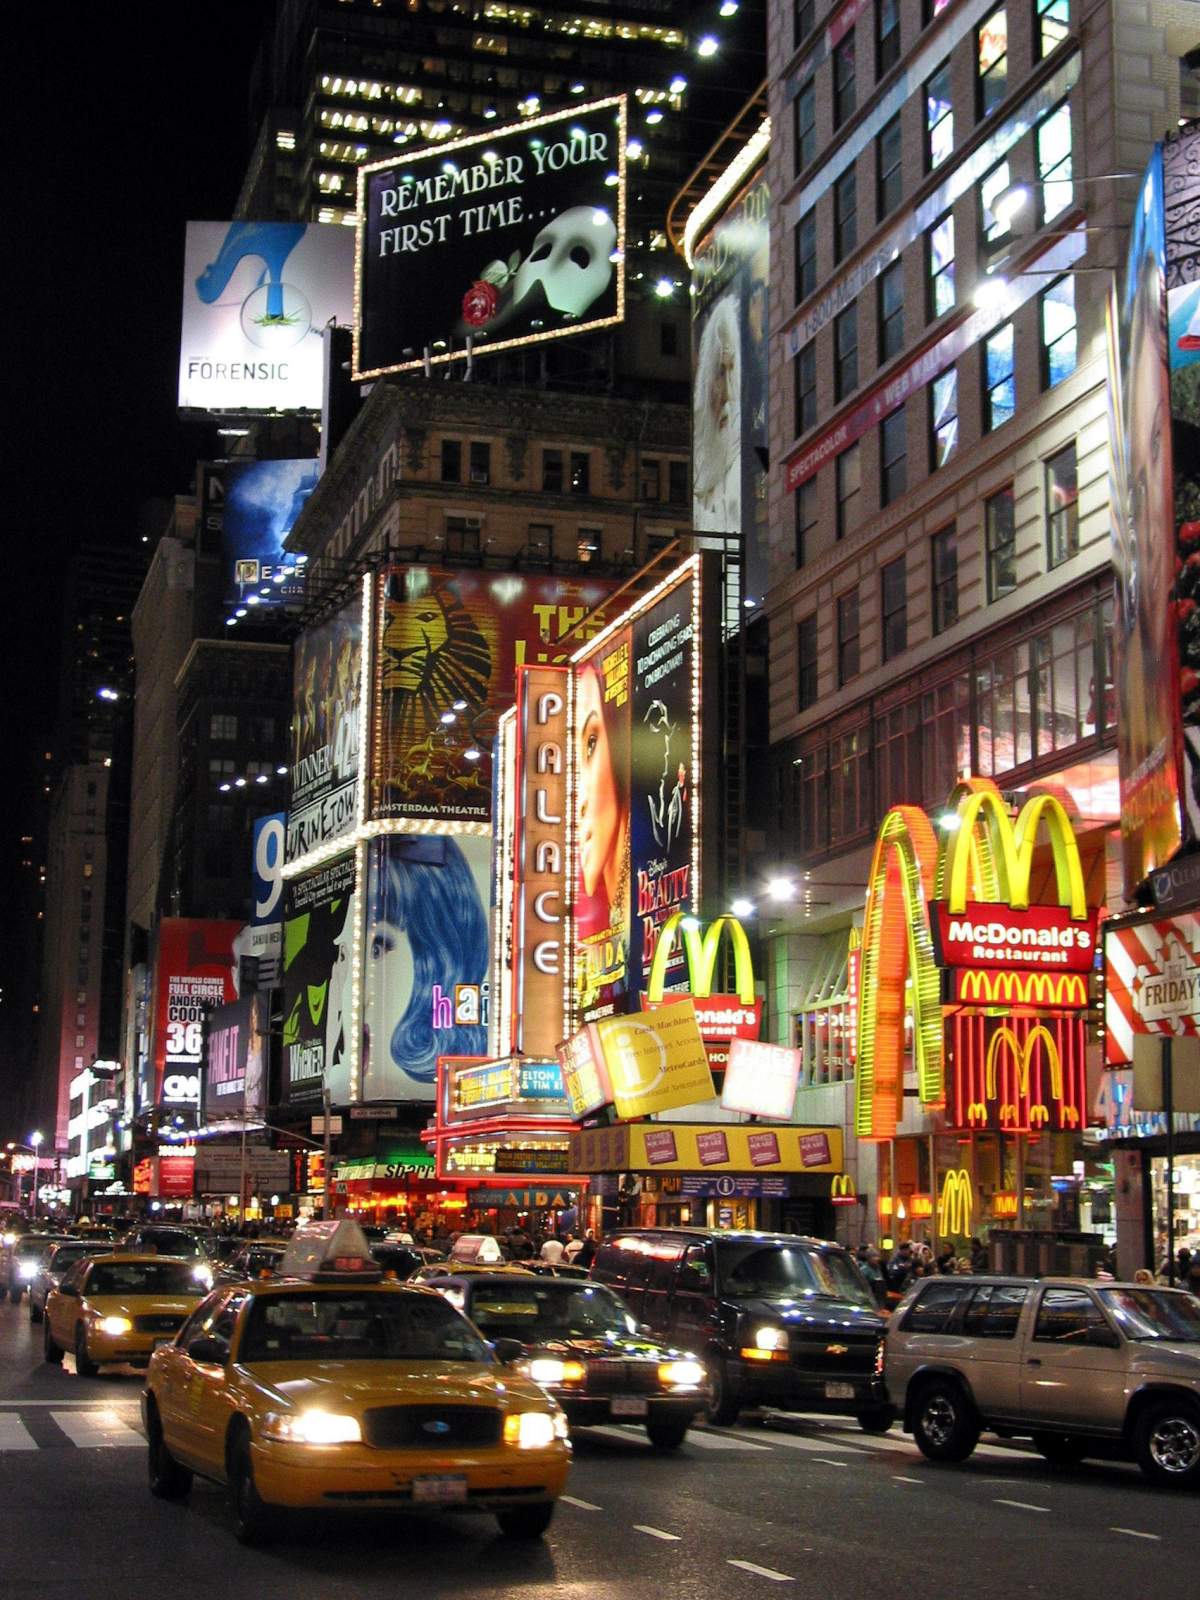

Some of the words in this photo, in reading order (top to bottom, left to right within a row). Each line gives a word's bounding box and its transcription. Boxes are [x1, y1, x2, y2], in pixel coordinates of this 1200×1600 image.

[380, 155, 524, 216] REMEMBER
[532, 132, 608, 175] YOUR
[379, 215, 452, 257] FIRST
[188, 362, 289, 380] FORENSIC
[533, 604, 606, 640] THE
[381, 803, 438, 813] AMSTERDAM
[440, 805, 488, 816] THEATRE,
[286, 786, 357, 861] URINETOW
[534, 692, 563, 975] PALACE
[637, 864, 690, 916] BEAUTY
[642, 916, 683, 962] BEST
[949, 921, 1091, 949] McDonald's
[973, 945, 1068, 962] Restaurant
[169, 984, 189, 993] FULL
[191, 985, 224, 995] CIRCLE
[169, 995, 224, 1007] ANDERON
[695, 1008, 756, 1025] onald's
[523, 1070, 554, 1080] ELTON
[533, 1080, 550, 1090] TIM
[504, 1192, 566, 1206] AIDA
